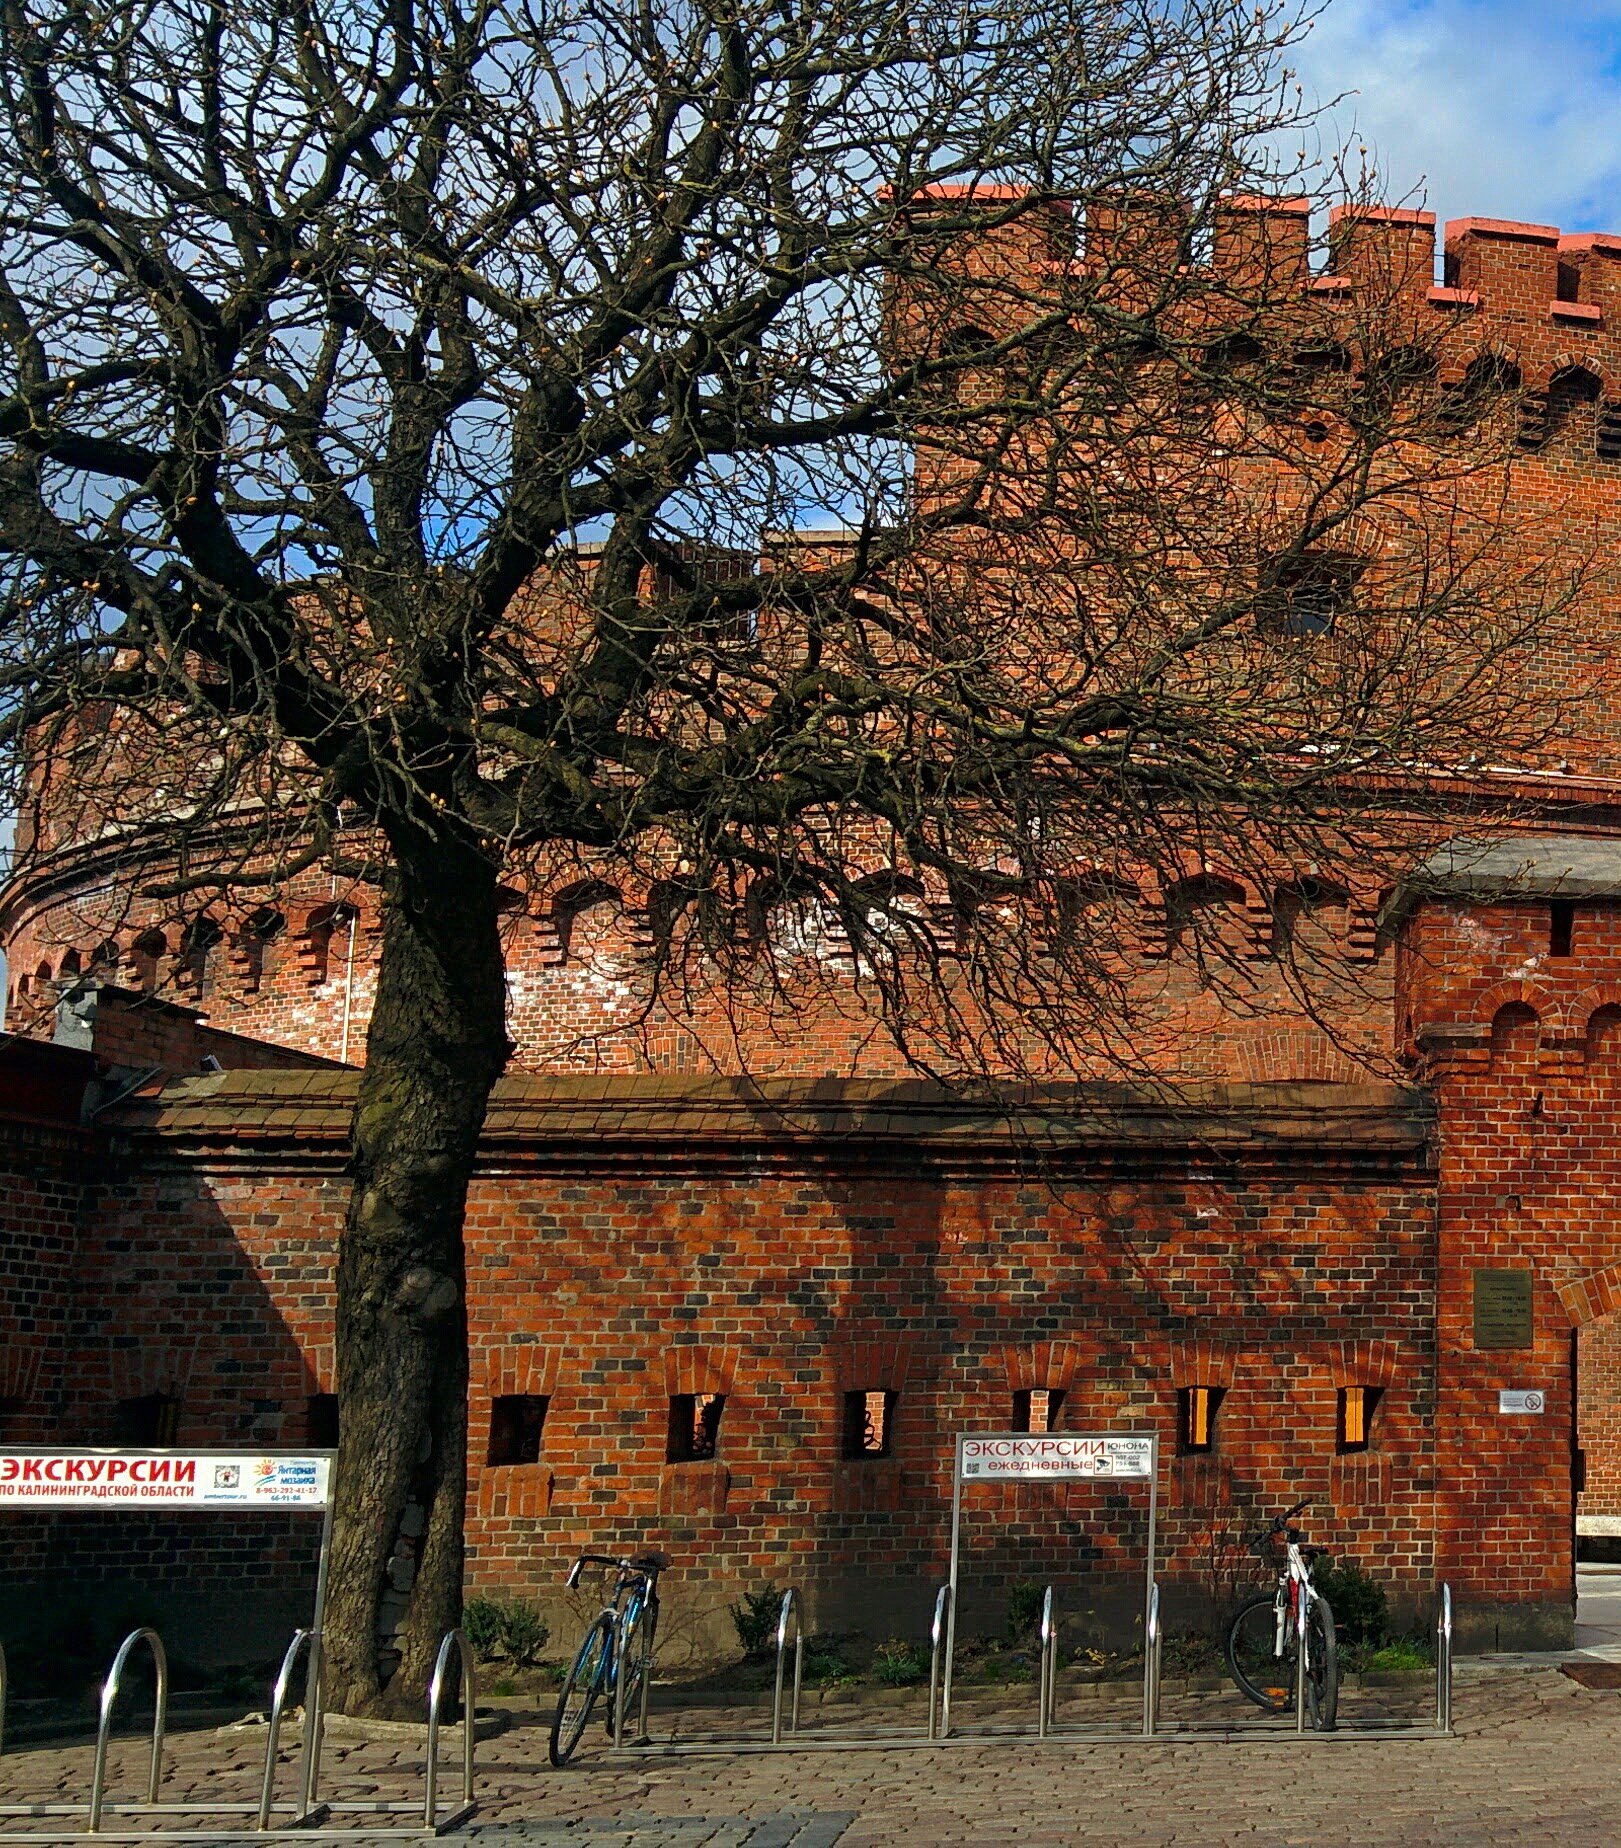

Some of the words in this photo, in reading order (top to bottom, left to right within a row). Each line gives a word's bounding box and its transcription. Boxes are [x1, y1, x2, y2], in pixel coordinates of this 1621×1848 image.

[965, 1441, 1105, 1456] ЭКСКУРСИИ
[1107, 1442, 1149, 1451] ЮНОНА
[0, 1458, 196, 1482] ЭКСКУРСИИ
[278, 1465, 316, 1476] Янтарная
[987, 1460, 1094, 1472] ежедневные
[280, 1477, 316, 1485] мозаика
[0, 1485, 14, 1495] ПО
[18, 1484, 138, 1498] КАЛИНИНГРАДСКОЙ
[141, 1485, 194, 1497] ОБЛАСТИ
